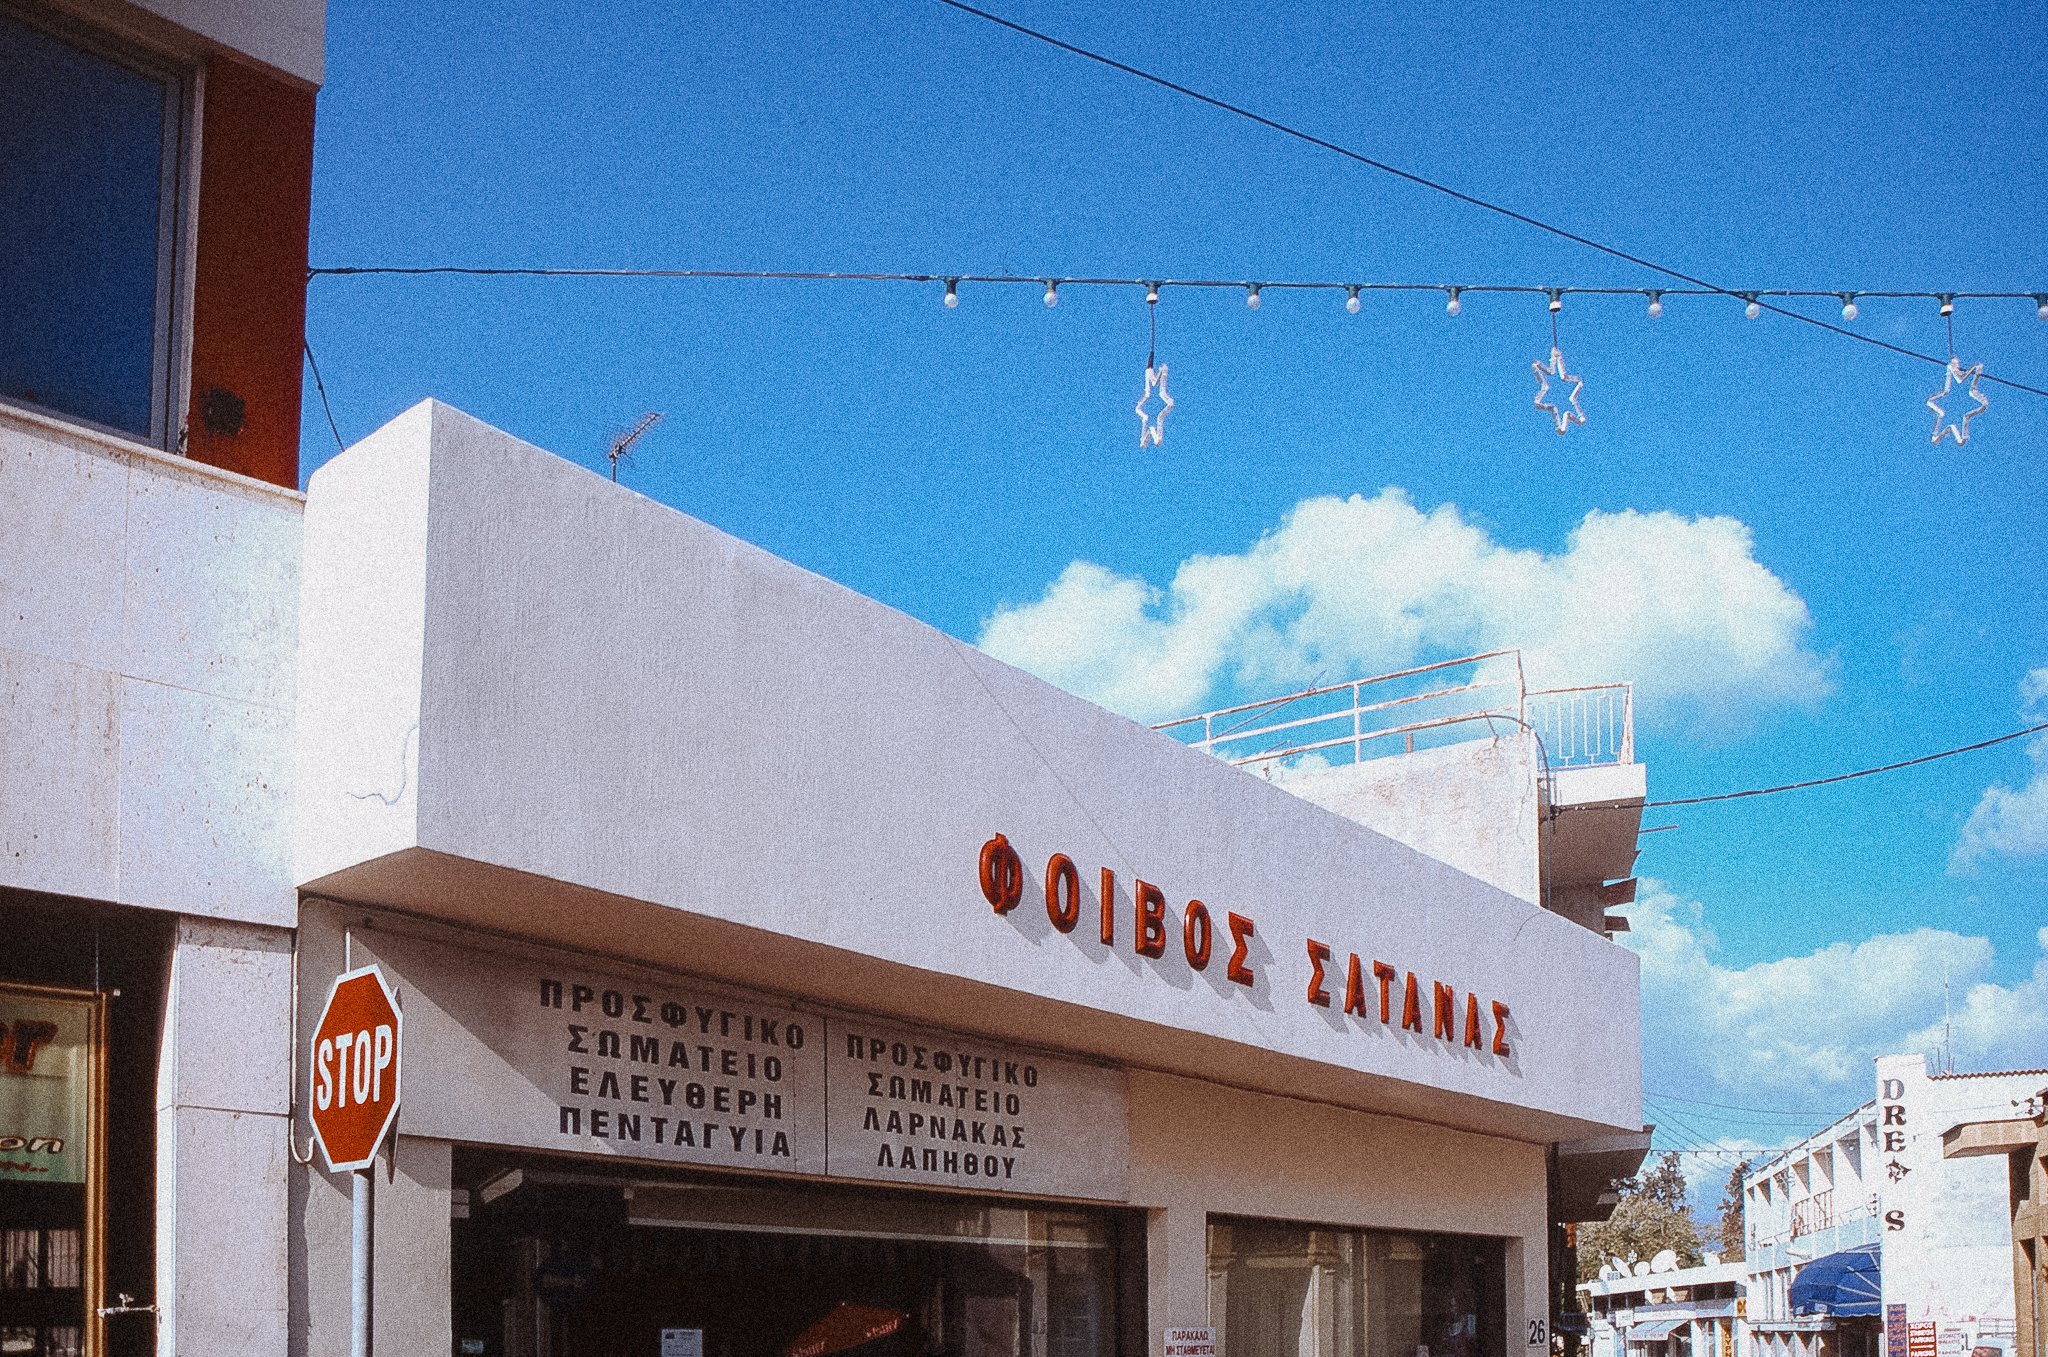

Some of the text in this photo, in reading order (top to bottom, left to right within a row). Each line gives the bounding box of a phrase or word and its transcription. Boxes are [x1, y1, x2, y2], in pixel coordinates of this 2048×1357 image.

[979, 832, 1511, 1058] ΦΟΙΒΟΣ ΣΑΤΑΝΑΣ
[540, 979, 805, 1049] ΠΡΟΣΦΥΓΙΚΟ
[317, 1024, 393, 1111] STOP
[568, 1024, 783, 1083] ΣΩΜΑΤΕΙΟ
[847, 1033, 1038, 1088] ΠΡΟΣΦΥΓΙΚΟ
[571, 1067, 783, 1120] ΕΛΕΥΘΕΡΗ
[867, 1072, 1021, 1117] ΣΩΜΑΤΕΙΟ
[559, 1107, 791, 1157] ΠΕΝΤΑΓΥΙΑ
[863, 1107, 1026, 1149] ΛΑΡΝΑΚΑΣ
[877, 1143, 1017, 1179] ΛΑΠΗΘΟΥ
[1172, 1330, 1209, 1341] ΠΑΡΑΚΑΛΩ
[1529, 1320, 1545, 1344] 26
